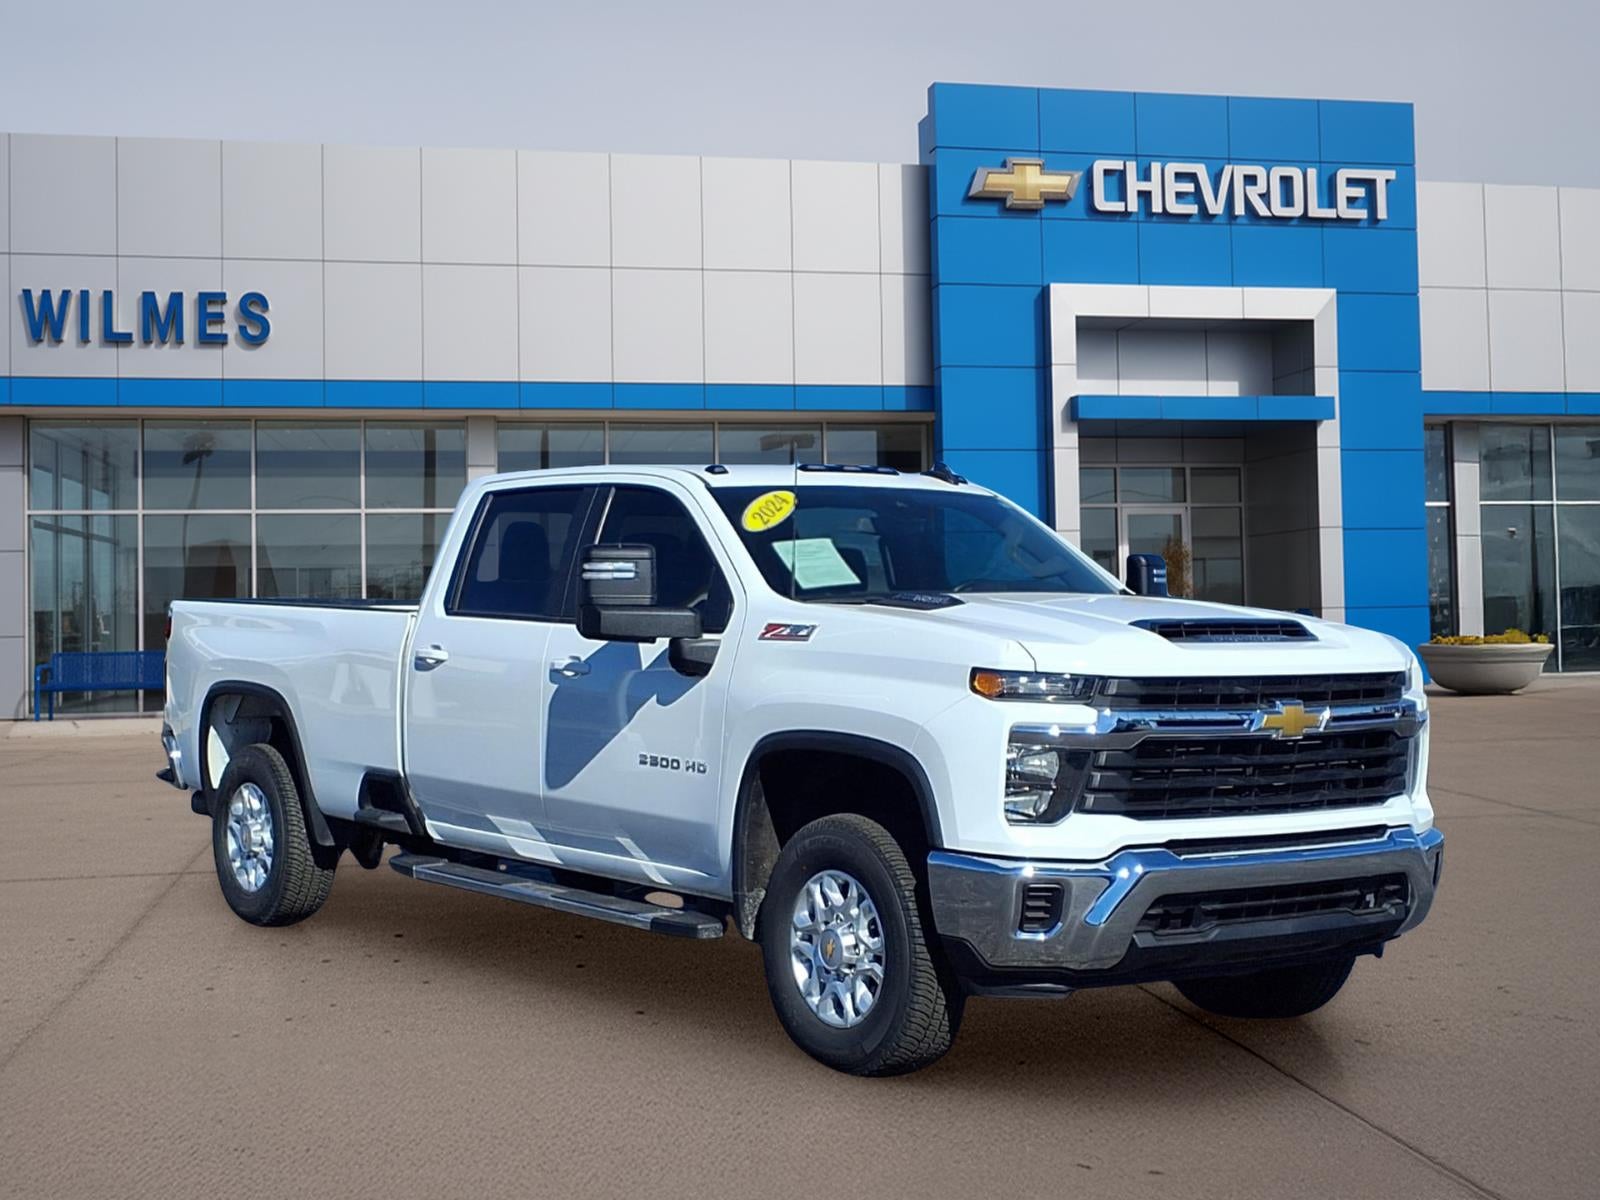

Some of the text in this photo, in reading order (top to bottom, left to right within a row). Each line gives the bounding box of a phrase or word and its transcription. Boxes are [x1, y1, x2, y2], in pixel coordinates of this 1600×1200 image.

[1093, 159, 1397, 220] CHEVROLET
[21, 288, 271, 346] WILMES
[751, 494, 790, 526] 2024
